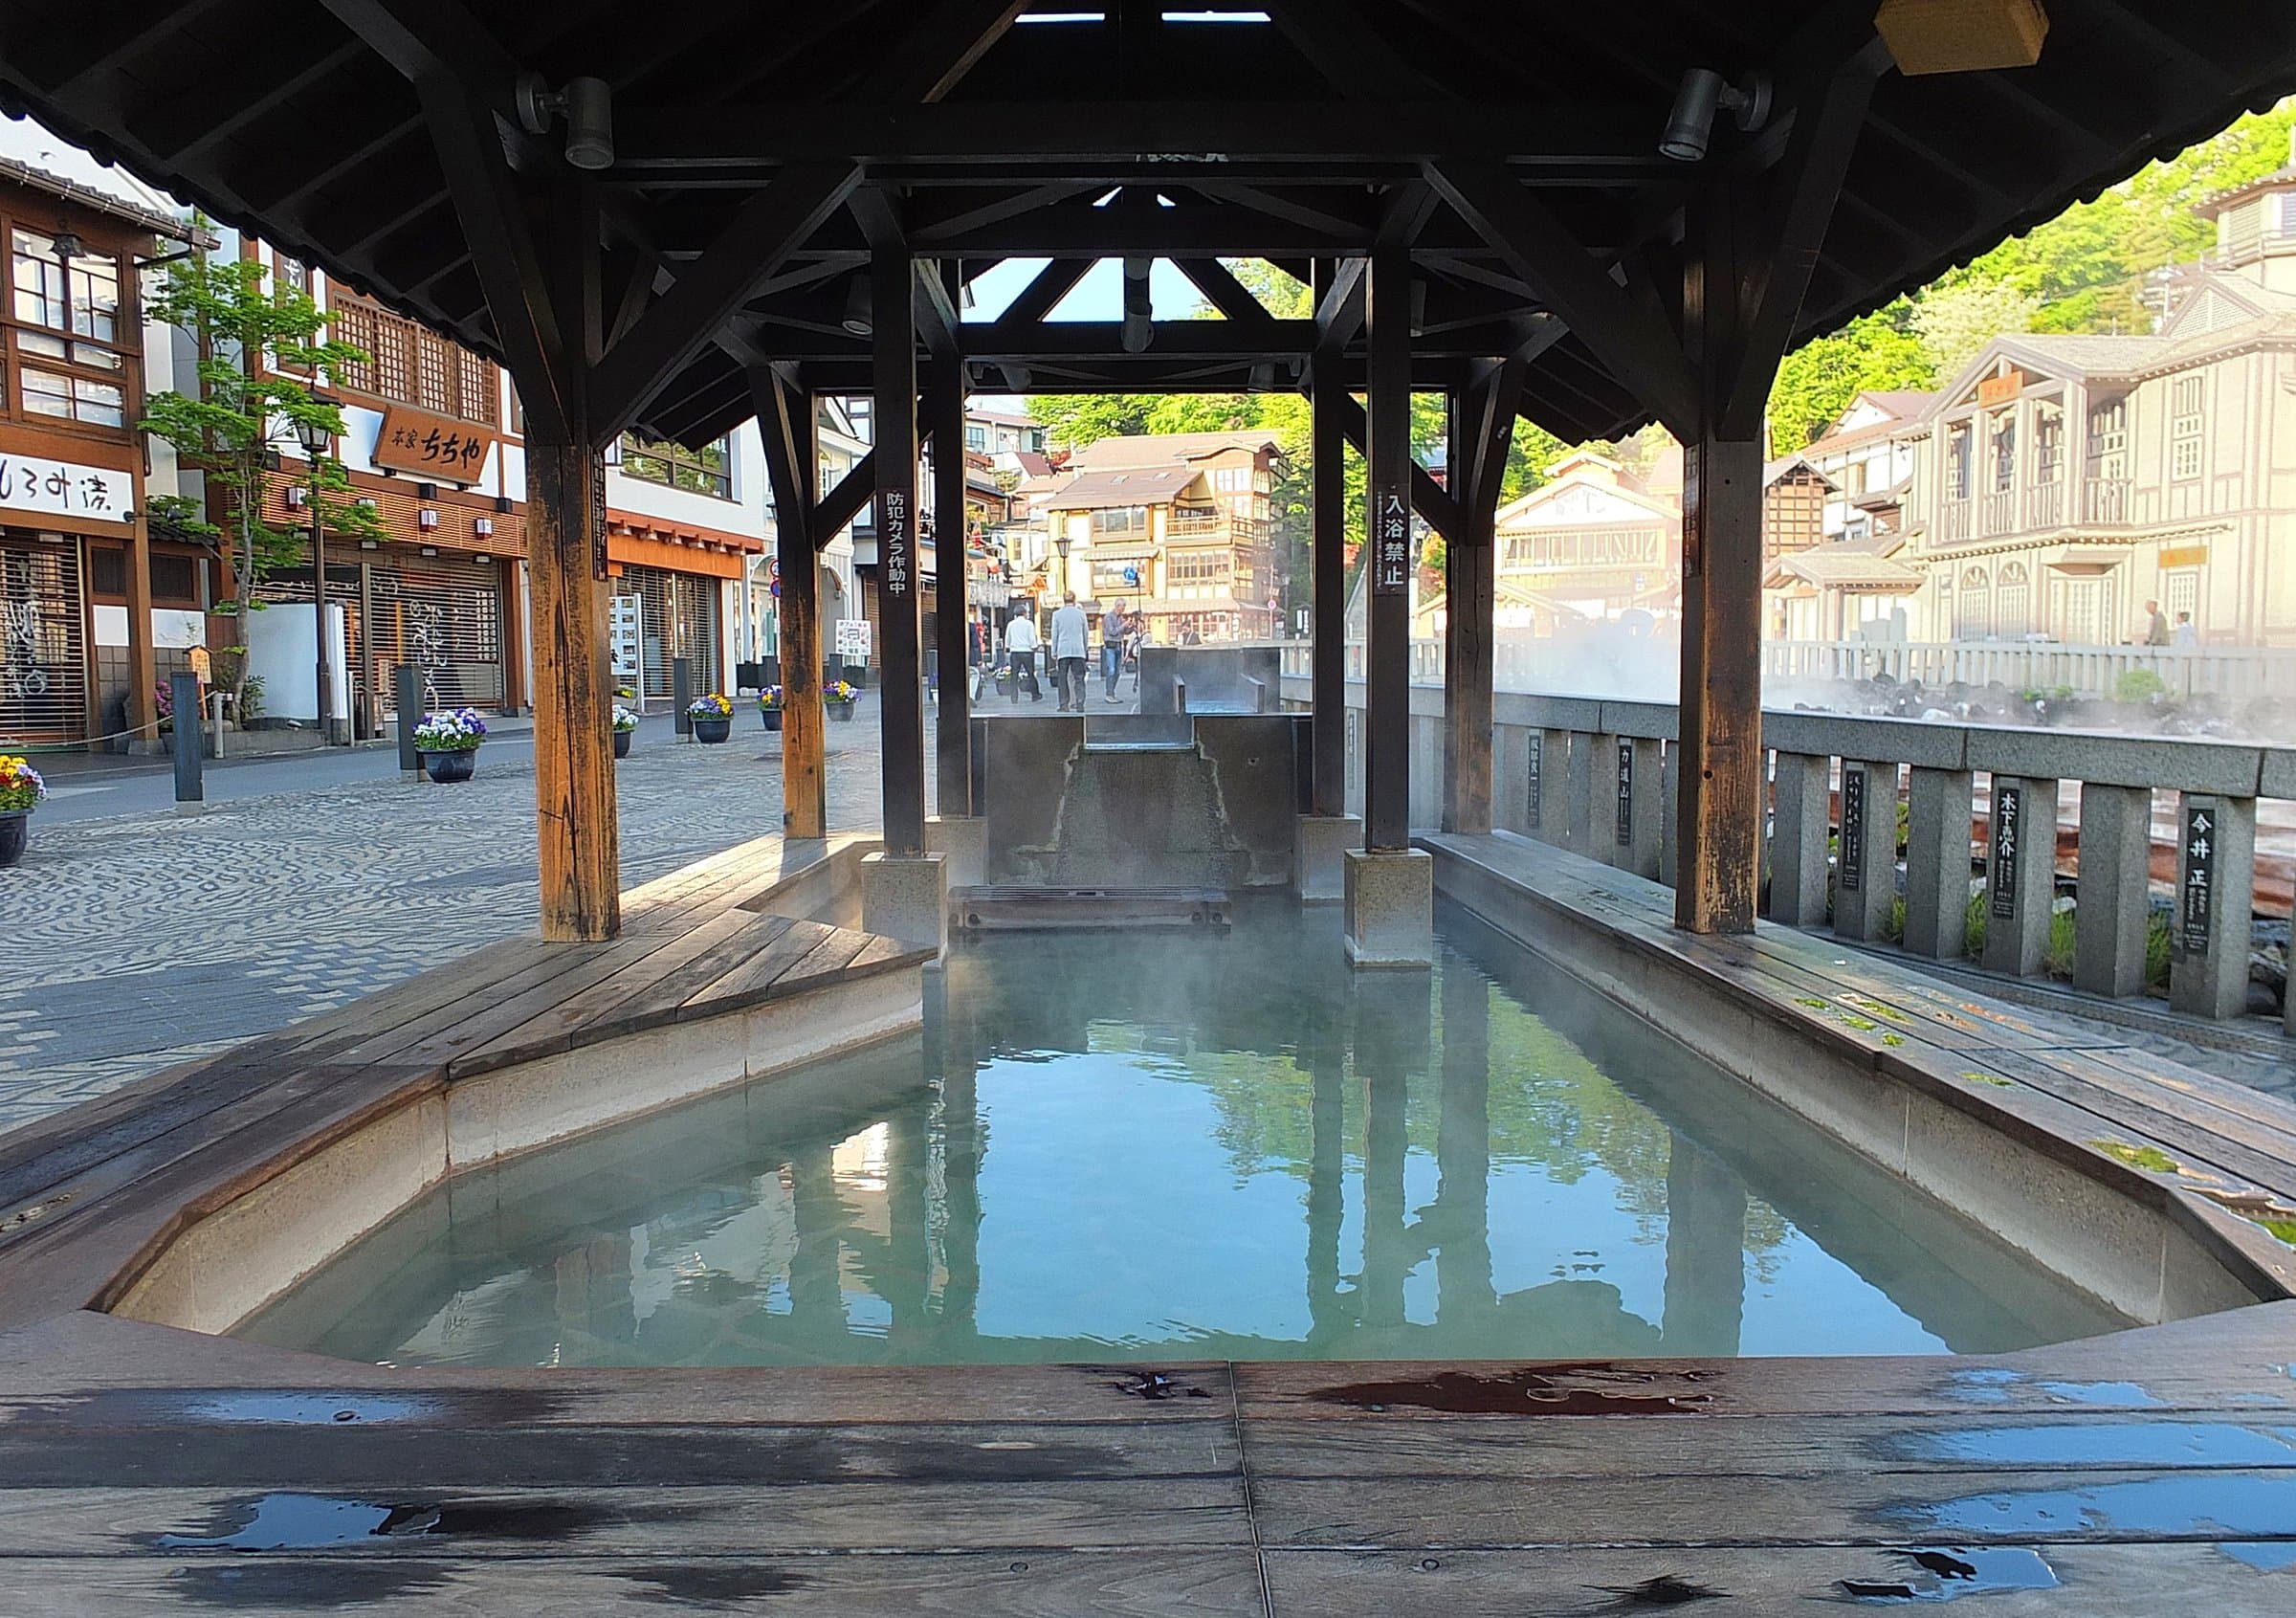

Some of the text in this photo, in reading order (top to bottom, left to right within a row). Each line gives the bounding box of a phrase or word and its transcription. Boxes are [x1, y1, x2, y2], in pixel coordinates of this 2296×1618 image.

[886, 493, 906, 594] 防犯カメラ作動中
[1385, 495, 1405, 586] 入浴禁止
